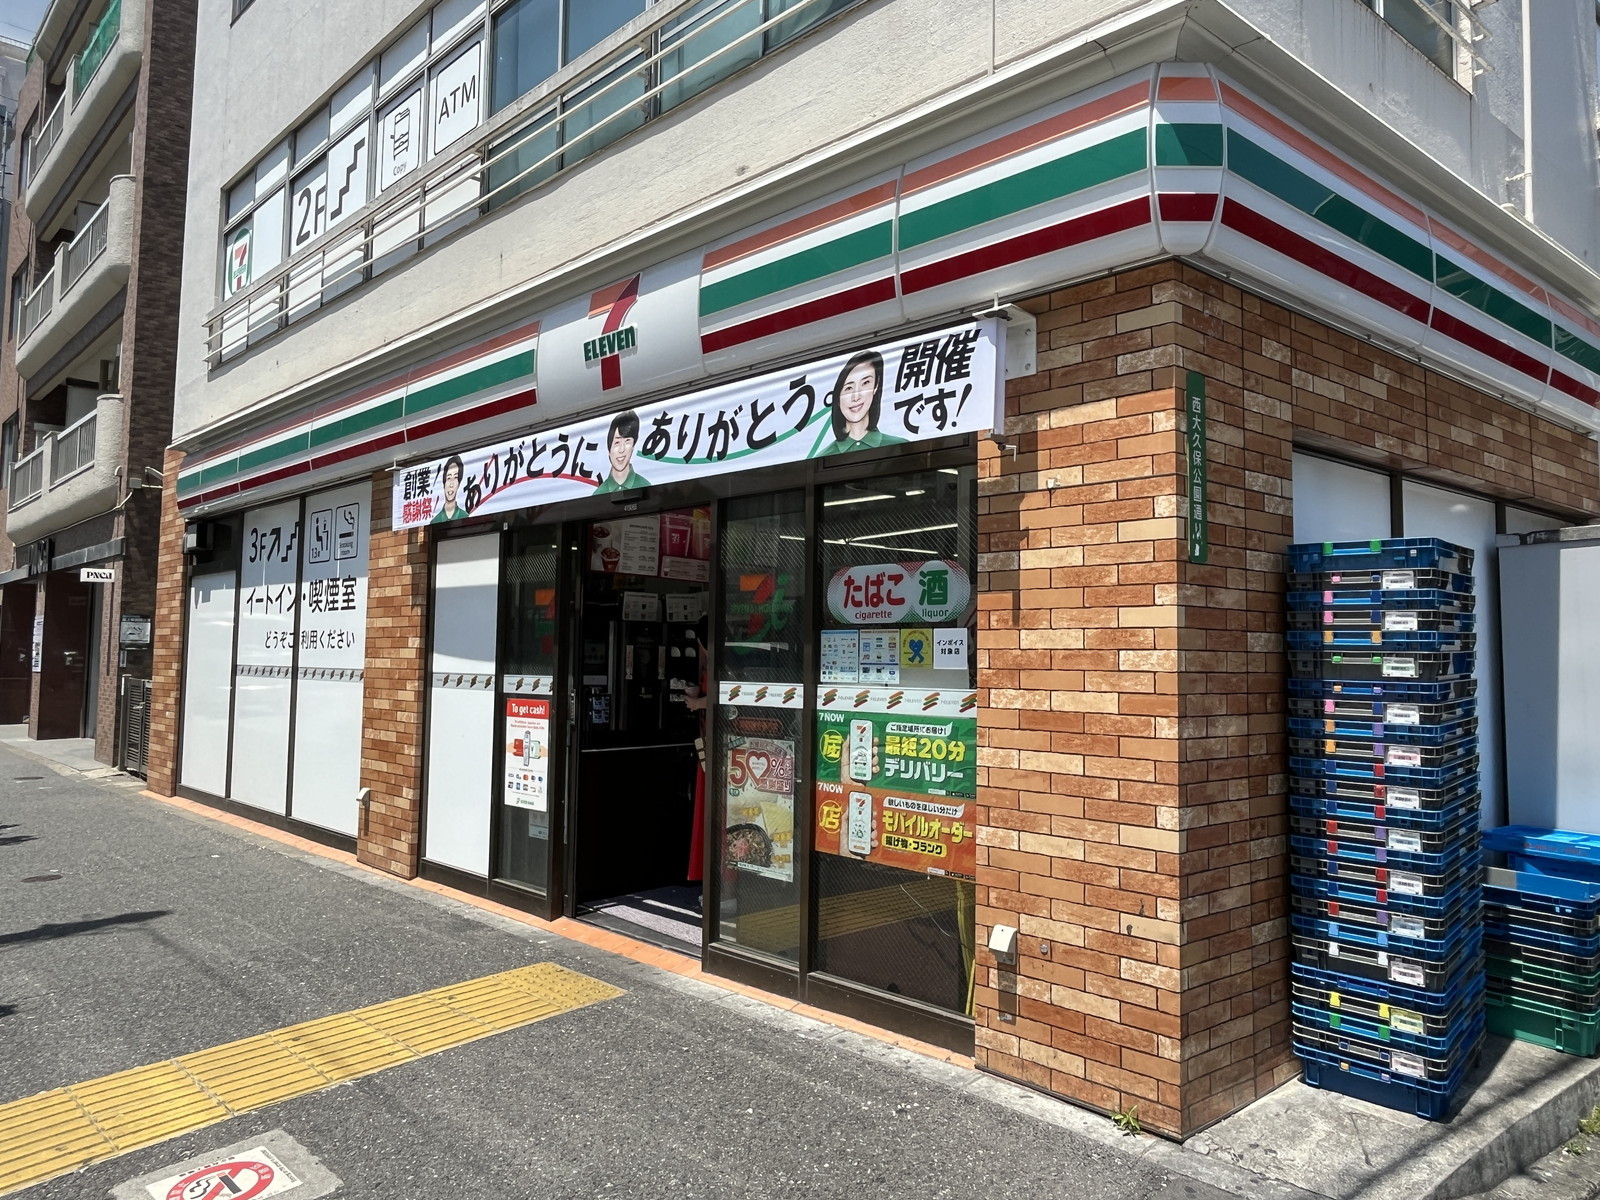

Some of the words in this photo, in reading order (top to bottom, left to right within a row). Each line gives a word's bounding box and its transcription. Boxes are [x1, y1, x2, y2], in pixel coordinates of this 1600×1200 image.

[438, 74, 476, 124] ATM
[295, 187, 326, 247] 2F
[894, 328, 982, 394] 開催
[249, 527, 267, 564] 3F
[843, 571, 906, 609] たばこ
[918, 569, 949, 606] 酒
[854, 610, 893, 621] cigarette
[921, 608, 949, 619] liquor
[936, 639, 964, 647] インボイス
[511, 702, 519, 714] To
[519, 704, 529, 716] get
[529, 705, 545, 715] cash!
[819, 712, 845, 723] 7NOW
[884, 735, 966, 762] 最短20分
[884, 757, 964, 783] デリバリー
[817, 781, 844, 794] 7NOW
[820, 805, 842, 830] 店
[881, 810, 974, 843] モバイルオーダー
[885, 835, 943, 856] 揚げ物・フランク
